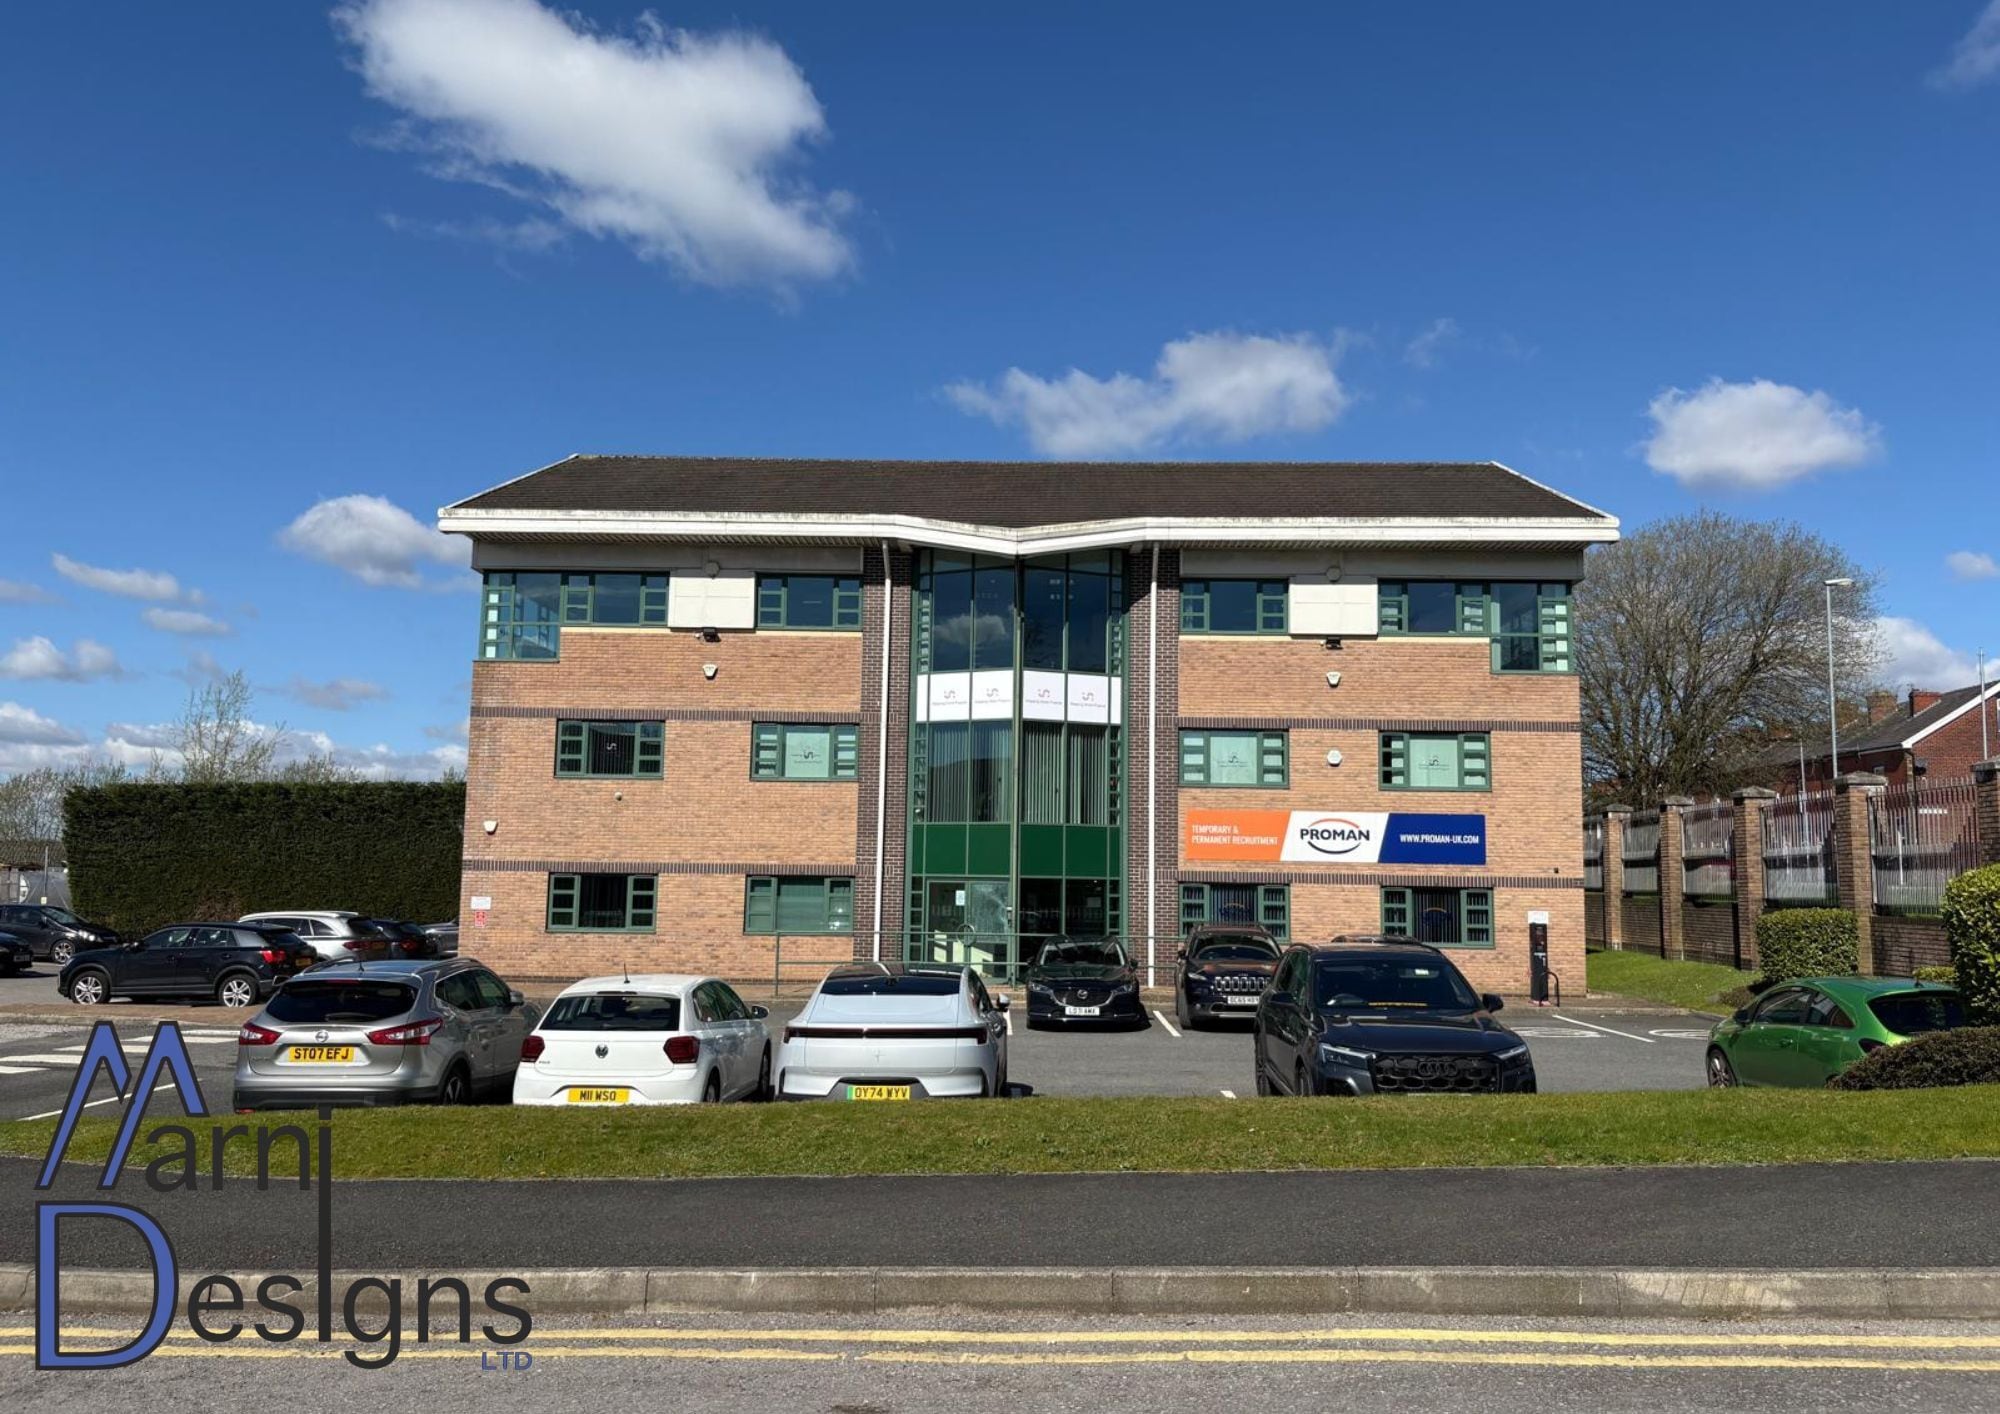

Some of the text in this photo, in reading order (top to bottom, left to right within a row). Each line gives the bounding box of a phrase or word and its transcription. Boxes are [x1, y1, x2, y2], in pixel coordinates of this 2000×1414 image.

[1192, 825, 1239, 834] TEMPORARY &
[1300, 828, 1370, 841] PROMAN
[1192, 835, 1278, 845] PERMANENT RECRUITMENT
[1400, 834, 1479, 844] WWW.PROMAN-UK.COM
[294, 1048, 349, 1060] ST07 EFJ
